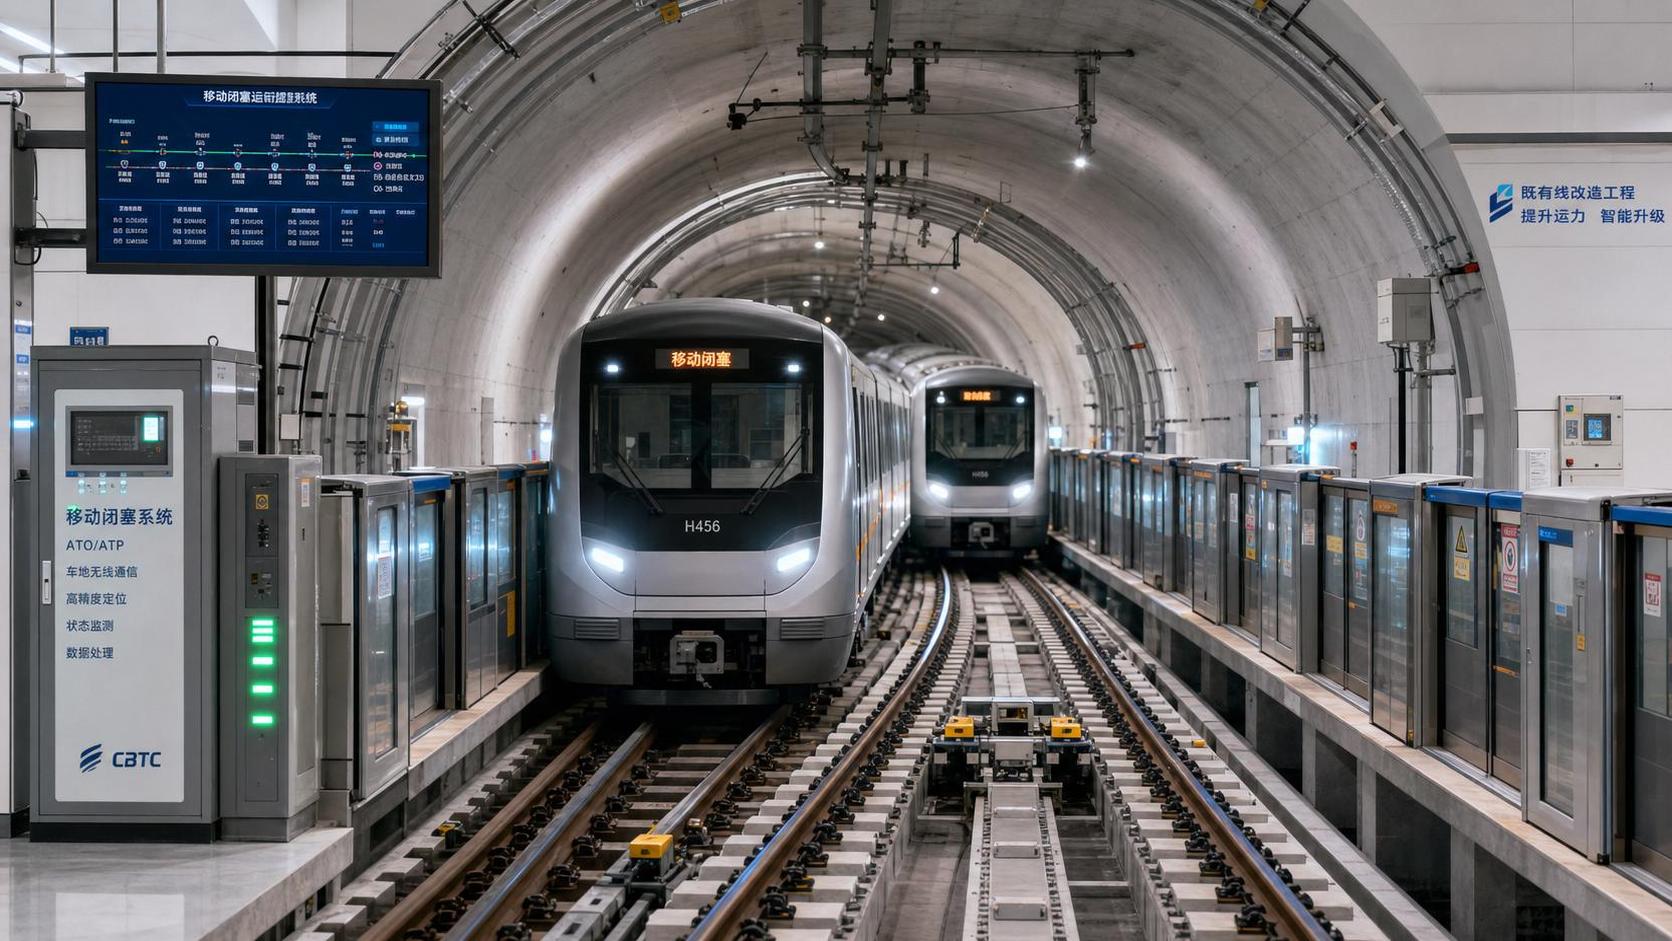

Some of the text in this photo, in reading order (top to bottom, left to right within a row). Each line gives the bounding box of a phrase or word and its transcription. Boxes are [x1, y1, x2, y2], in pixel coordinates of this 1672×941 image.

[1521, 185, 1635, 200] 既有线改造工程
[1521, 209, 1665, 224] 提升运力 智能升级
[671, 351, 732, 367] 移动闭塞
[65, 507, 173, 525] 移动闭塞系统
[685, 520, 721, 532] H456
[65, 539, 125, 551] ATO/ATP
[66, 565, 138, 578] 车地无线通信
[66, 593, 127, 605] 高精度定位
[66, 620, 114, 632] 状态监测
[66, 647, 114, 659] 数据处理
[112, 752, 161, 767] CBTC
